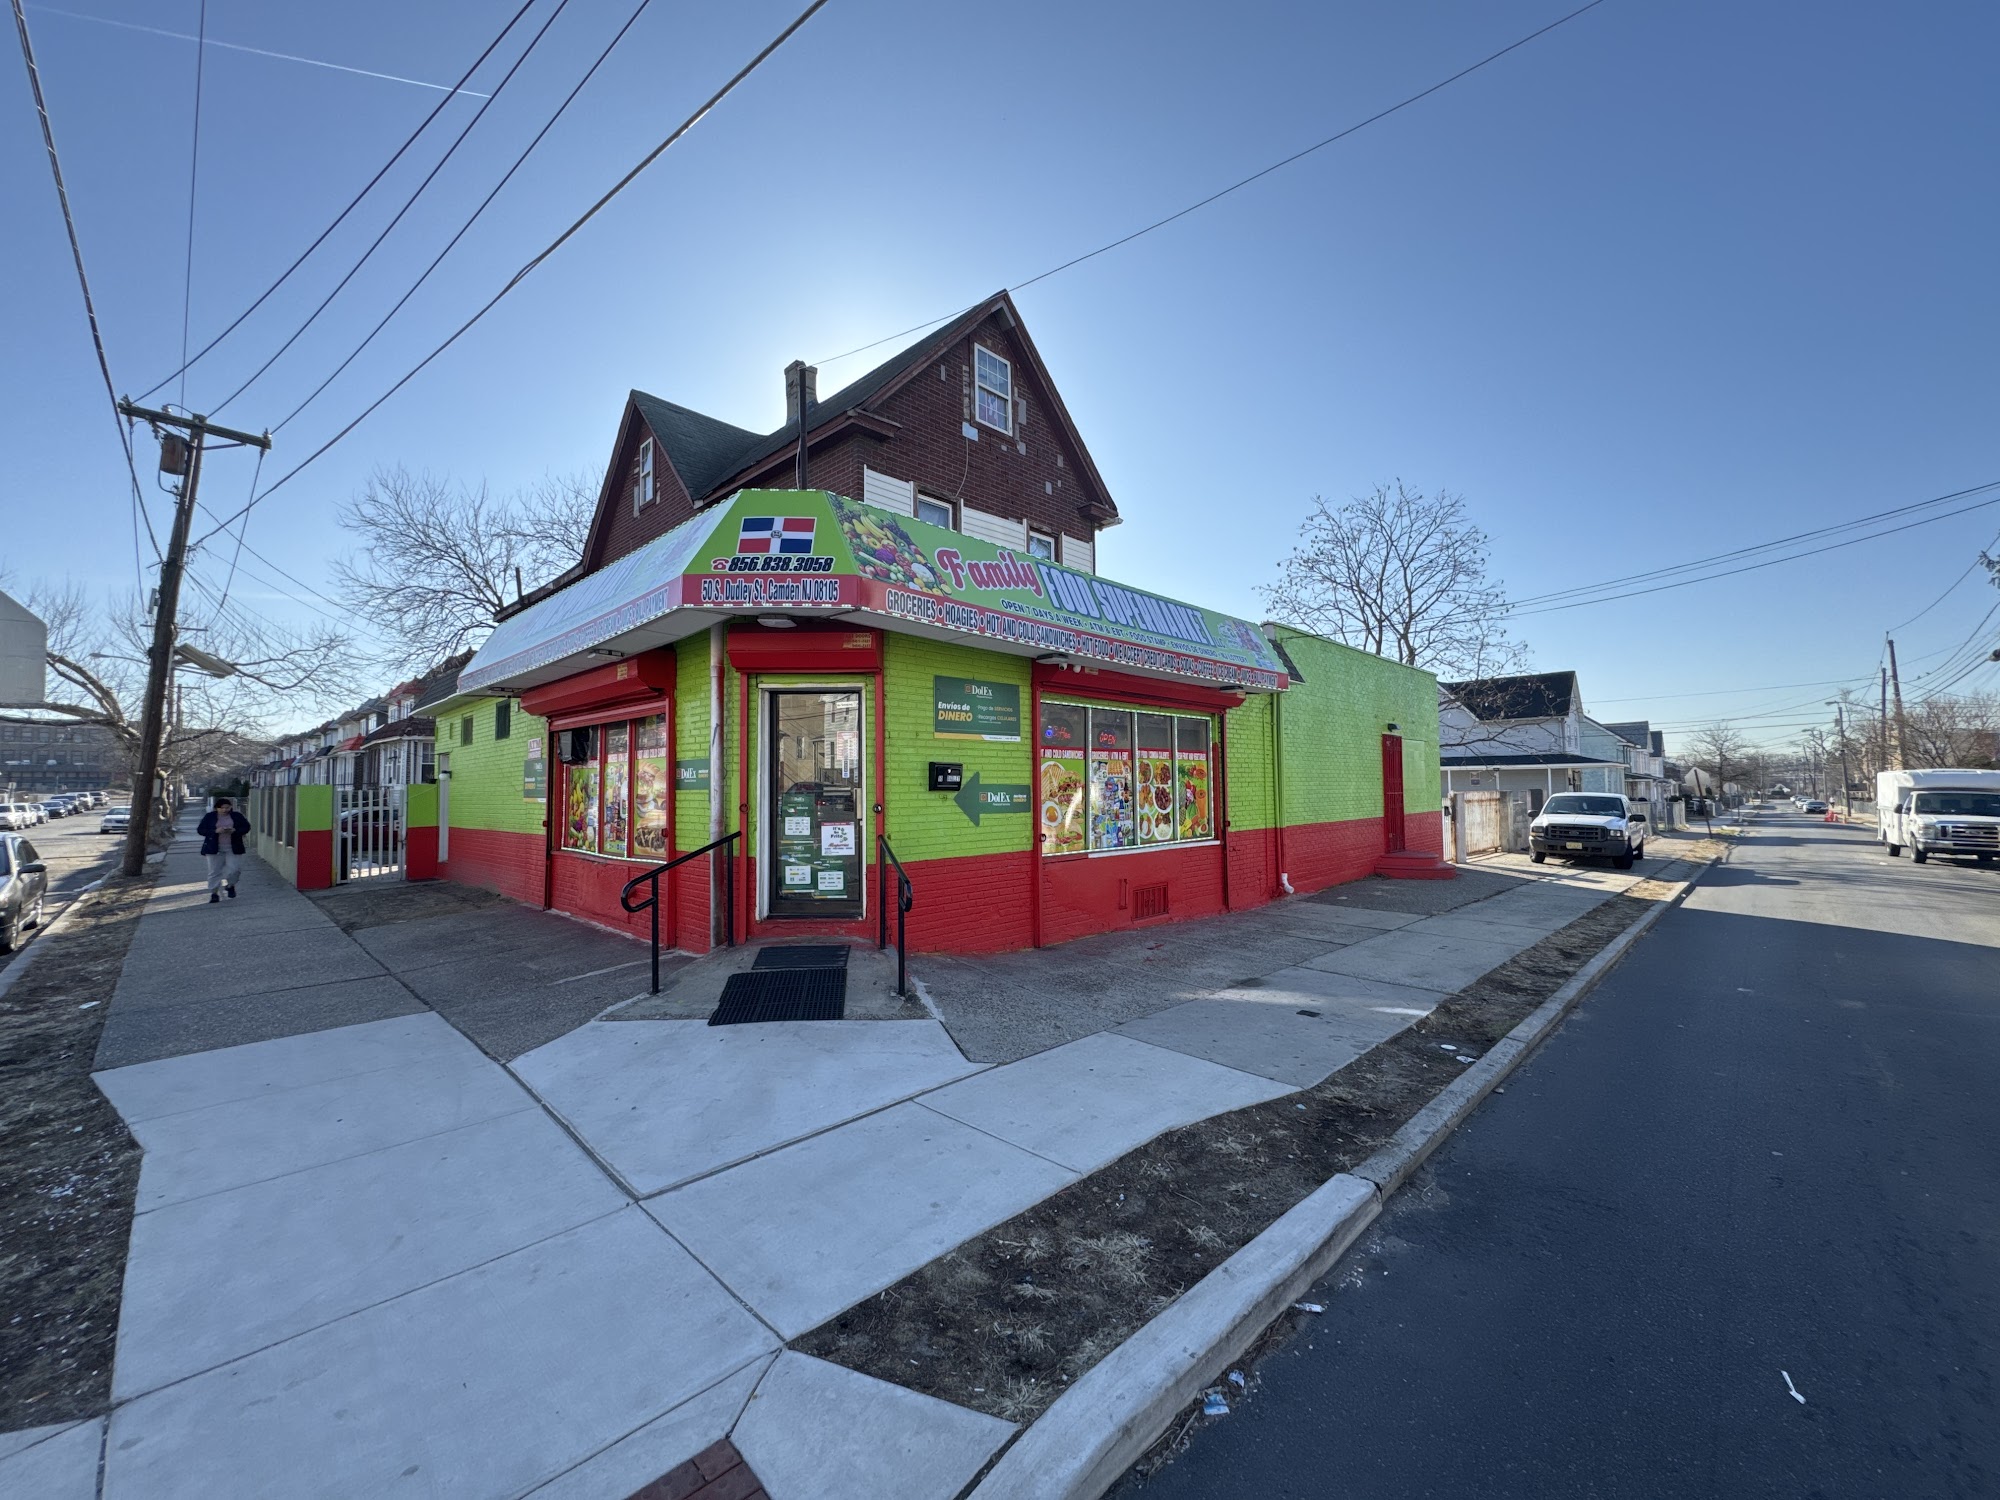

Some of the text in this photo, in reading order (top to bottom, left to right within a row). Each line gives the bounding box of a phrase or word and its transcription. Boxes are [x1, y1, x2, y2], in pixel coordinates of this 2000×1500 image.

[728, 556, 834, 573] 856.838.3058
[935, 547, 1044, 598] Family
[701, 578, 839, 604] 50 S. Dudley St, Camden NJ 08105
[1035, 561, 1101, 620] FOOD
[1089, 577, 1216, 648] SUPERMARKET
[1001, 599, 1024, 615] OPEN
[1026, 606, 1031, 614] 7
[1032, 607, 1053, 621] DAYS
[1056, 613, 1061, 622] A
[1061, 614, 1084, 628] WEEK
[1089, 623, 1104, 633] ATM
[1112, 628, 1125, 638] EBT
[1129, 630, 1147, 642] FOOD
[886, 588, 937, 621] GROCERIES
[944, 602, 979, 630] HOAGIES
[985, 612, 1001, 634] HOT
[1002, 616, 1016, 638] AND
[1018, 620, 1035, 642] COLD
[1035, 624, 1076, 651] SANDWICHES
[1081, 634, 1093, 654] HOT
[1093, 638, 1110, 658] FOOD
[1113, 642, 1123, 659] WE
[1122, 643, 1144, 665] ACCEPT
[1144, 648, 1162, 667] CREDIT
[1161, 652, 1177, 670] CARDS
[1197, 659, 1214, 677] COFFEE
[972, 685, 993, 696] DolEx
[938, 701, 970, 711] Envíos de
[938, 710, 973, 722] DINERO
[681, 767, 697, 779] DolEx
[988, 792, 1011, 802] DolEx
